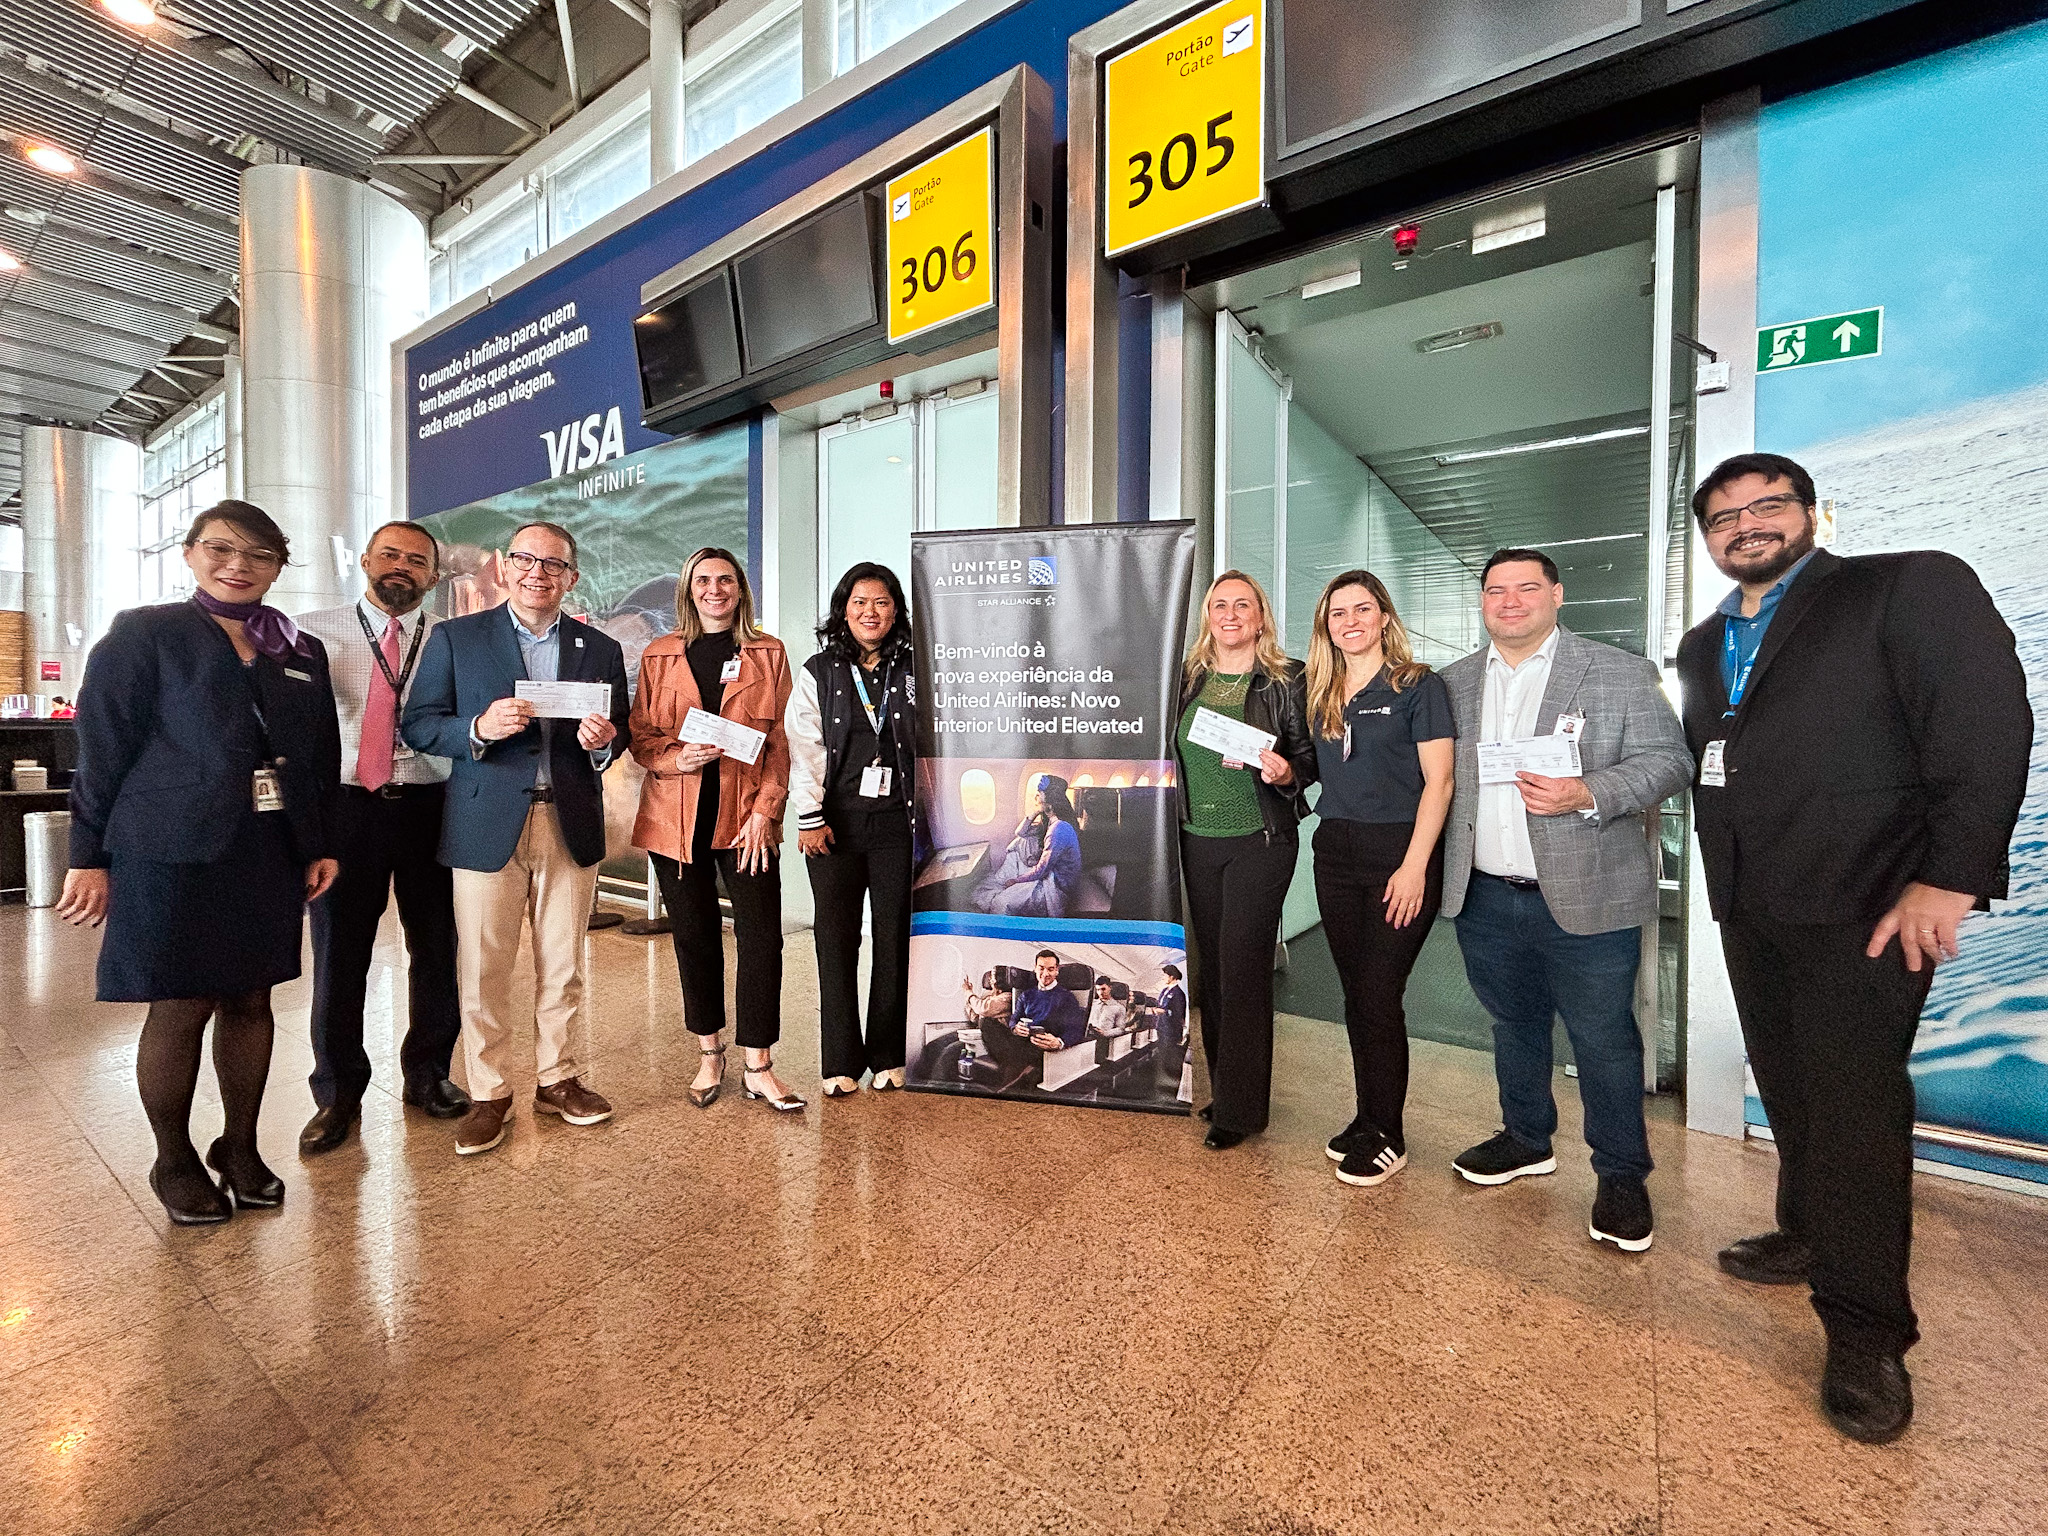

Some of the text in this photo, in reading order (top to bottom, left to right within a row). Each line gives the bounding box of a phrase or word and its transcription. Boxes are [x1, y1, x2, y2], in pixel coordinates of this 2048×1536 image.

[1166, 33, 1213, 66] Portão
[1179, 53, 1214, 78] Gate
[1128, 110, 1235, 210] 305
[913, 177, 942, 199] Portão
[914, 193, 935, 212] Gate
[902, 229, 977, 305] 306
[418, 301, 576, 392] O mundo é Infinite para quem
[418, 324, 589, 416] tem benefícios que acompanham
[418, 370, 556, 440] cada etapa da sua viagem.
[539, 405, 625, 479] VISA
[578, 462, 646, 501] INFINITE
[951, 559, 1023, 574] UNITED
[934, 572, 1023, 588] AIRLINES
[977, 597, 1042, 607] STAR ALLIANCE
[934, 641, 1046, 660] Bem-vindo à
[934, 665, 1114, 687] nova experiência da
[934, 691, 1121, 709] United Airlines: Novo
[934, 716, 1144, 734] interior United Elevated
